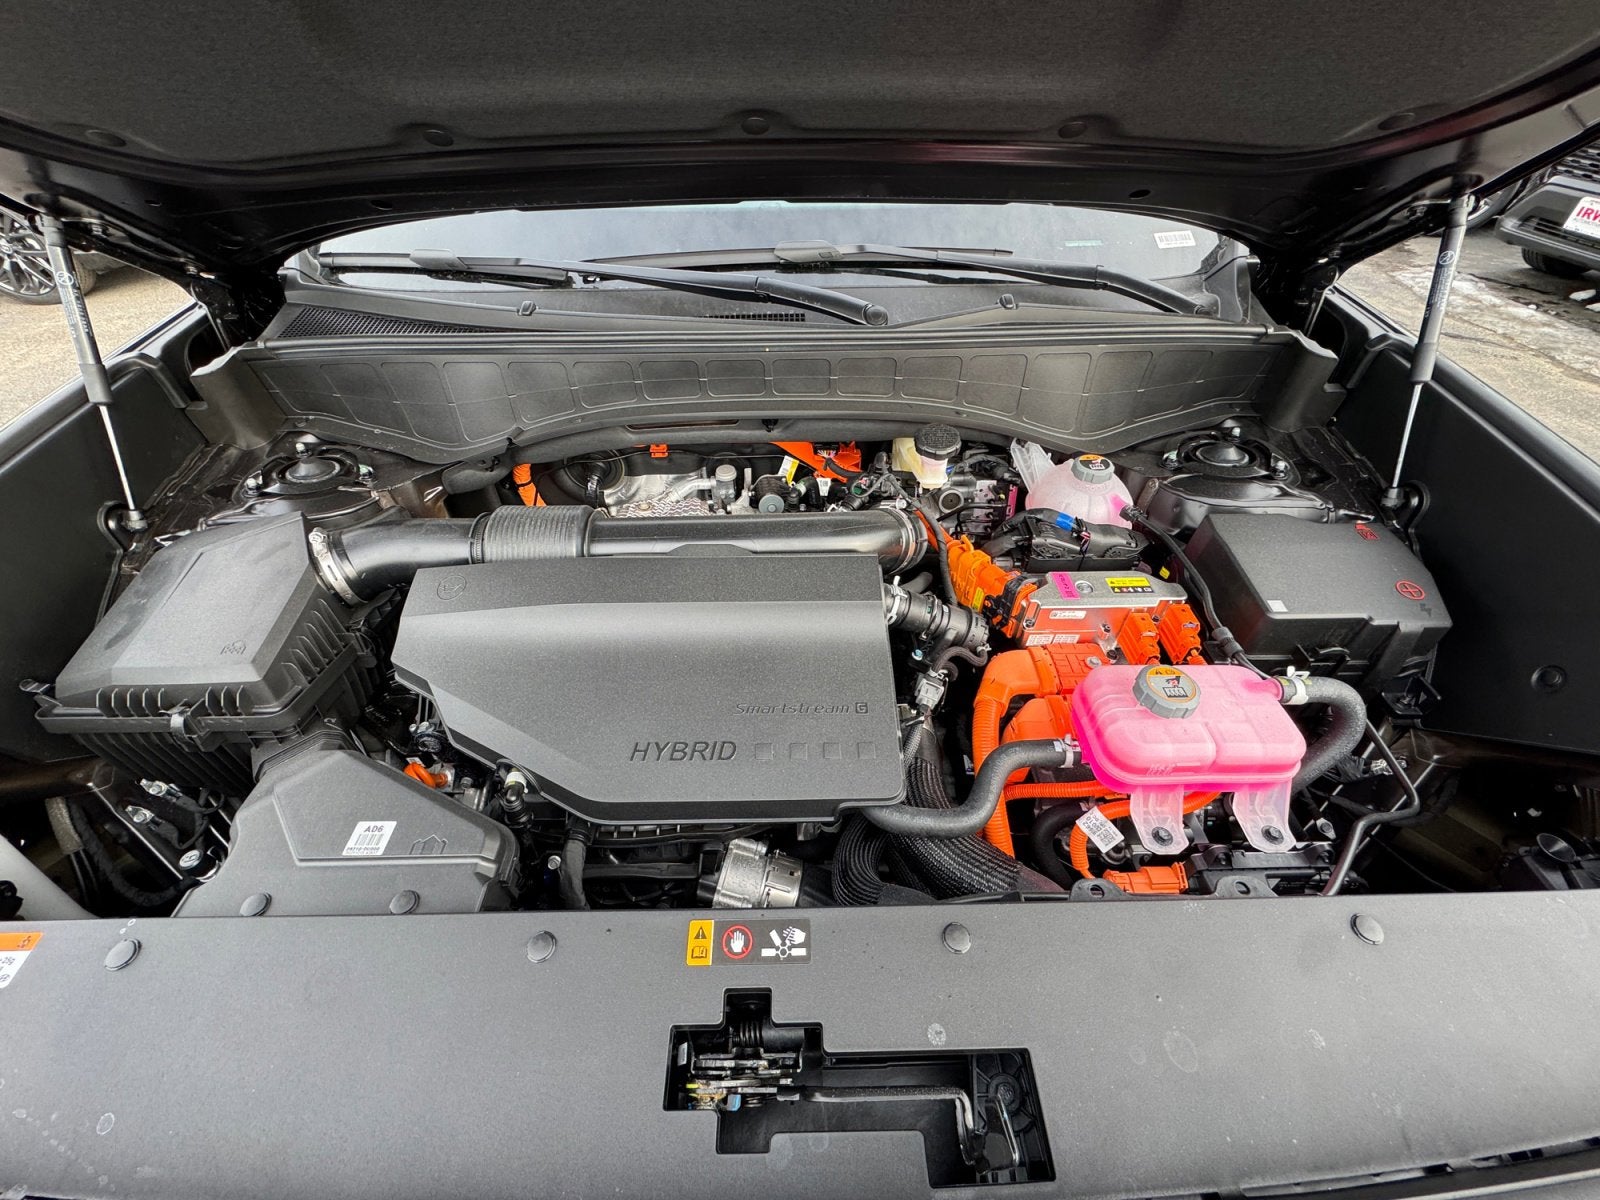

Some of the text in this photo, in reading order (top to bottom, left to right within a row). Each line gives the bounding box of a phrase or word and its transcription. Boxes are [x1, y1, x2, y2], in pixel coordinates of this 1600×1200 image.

[733, 701, 869, 715] Smartstream G
[629, 740, 738, 762] HYBRID
[364, 825, 384, 833] AD6
